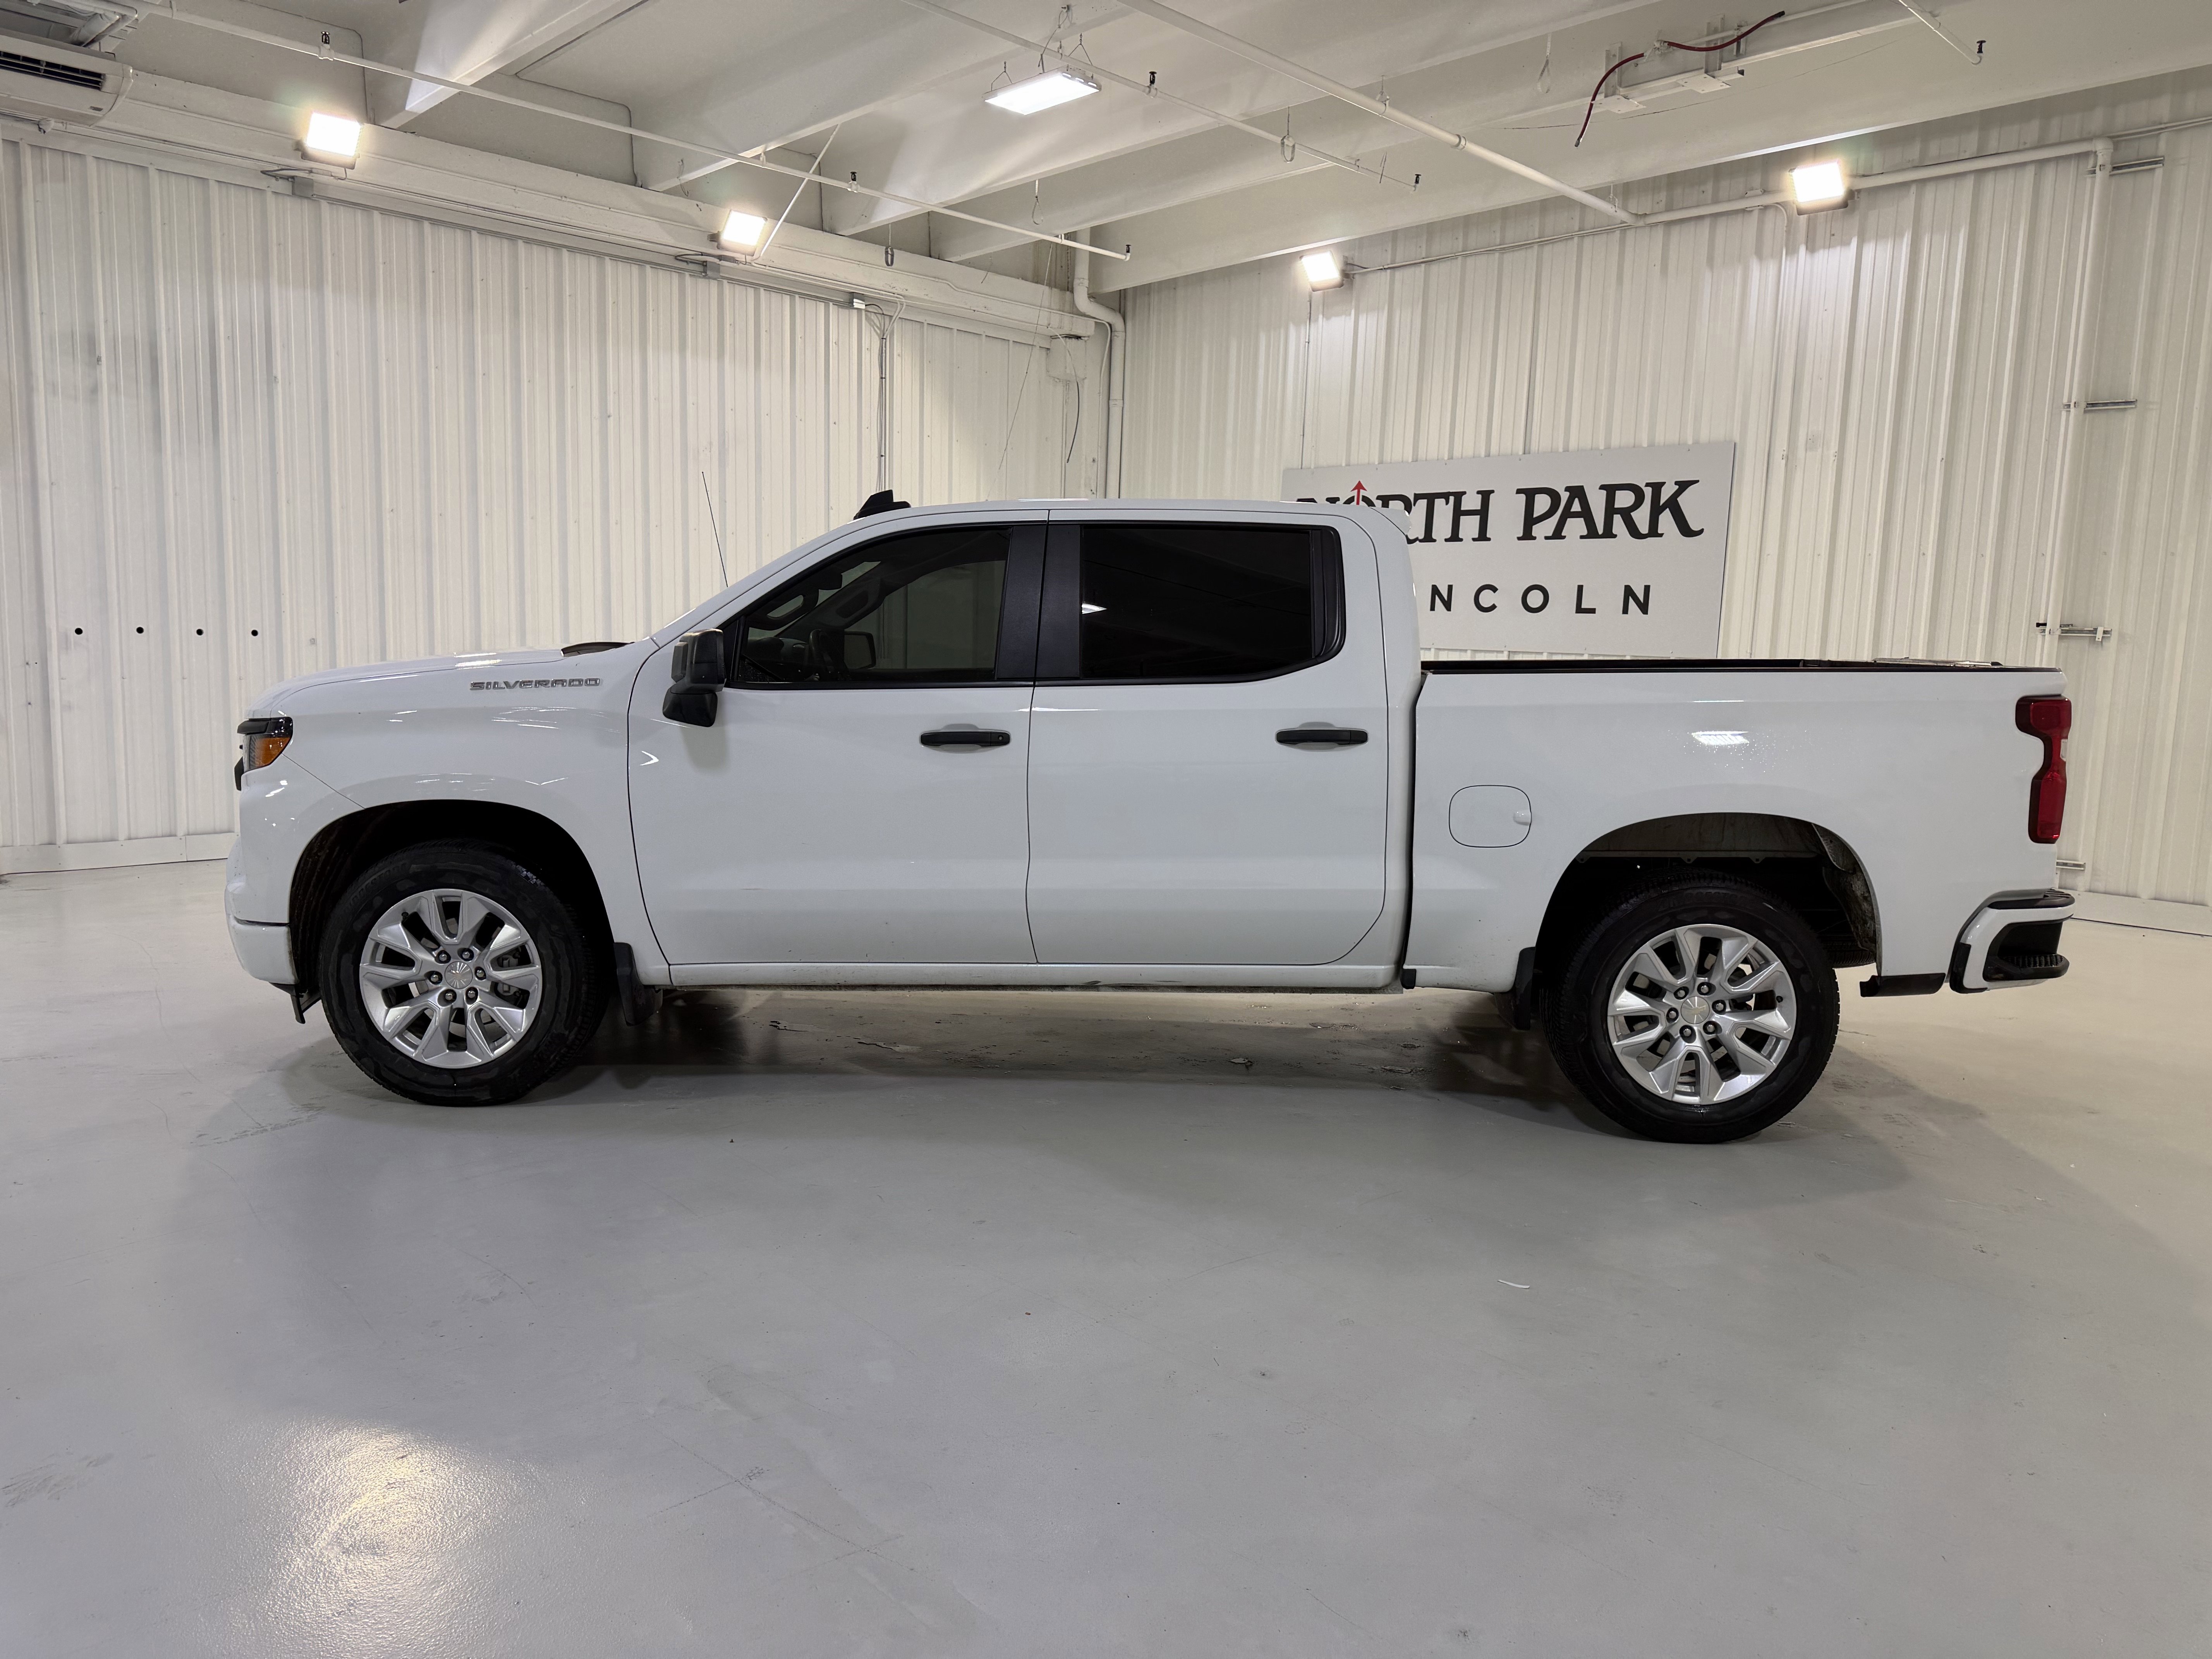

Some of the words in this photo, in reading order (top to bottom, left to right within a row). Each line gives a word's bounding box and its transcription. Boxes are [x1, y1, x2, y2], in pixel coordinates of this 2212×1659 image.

[1515, 479, 1704, 541] PARK
[1429, 583, 1651, 615] NCOLN
[469, 678, 601, 690] SILVERADO
